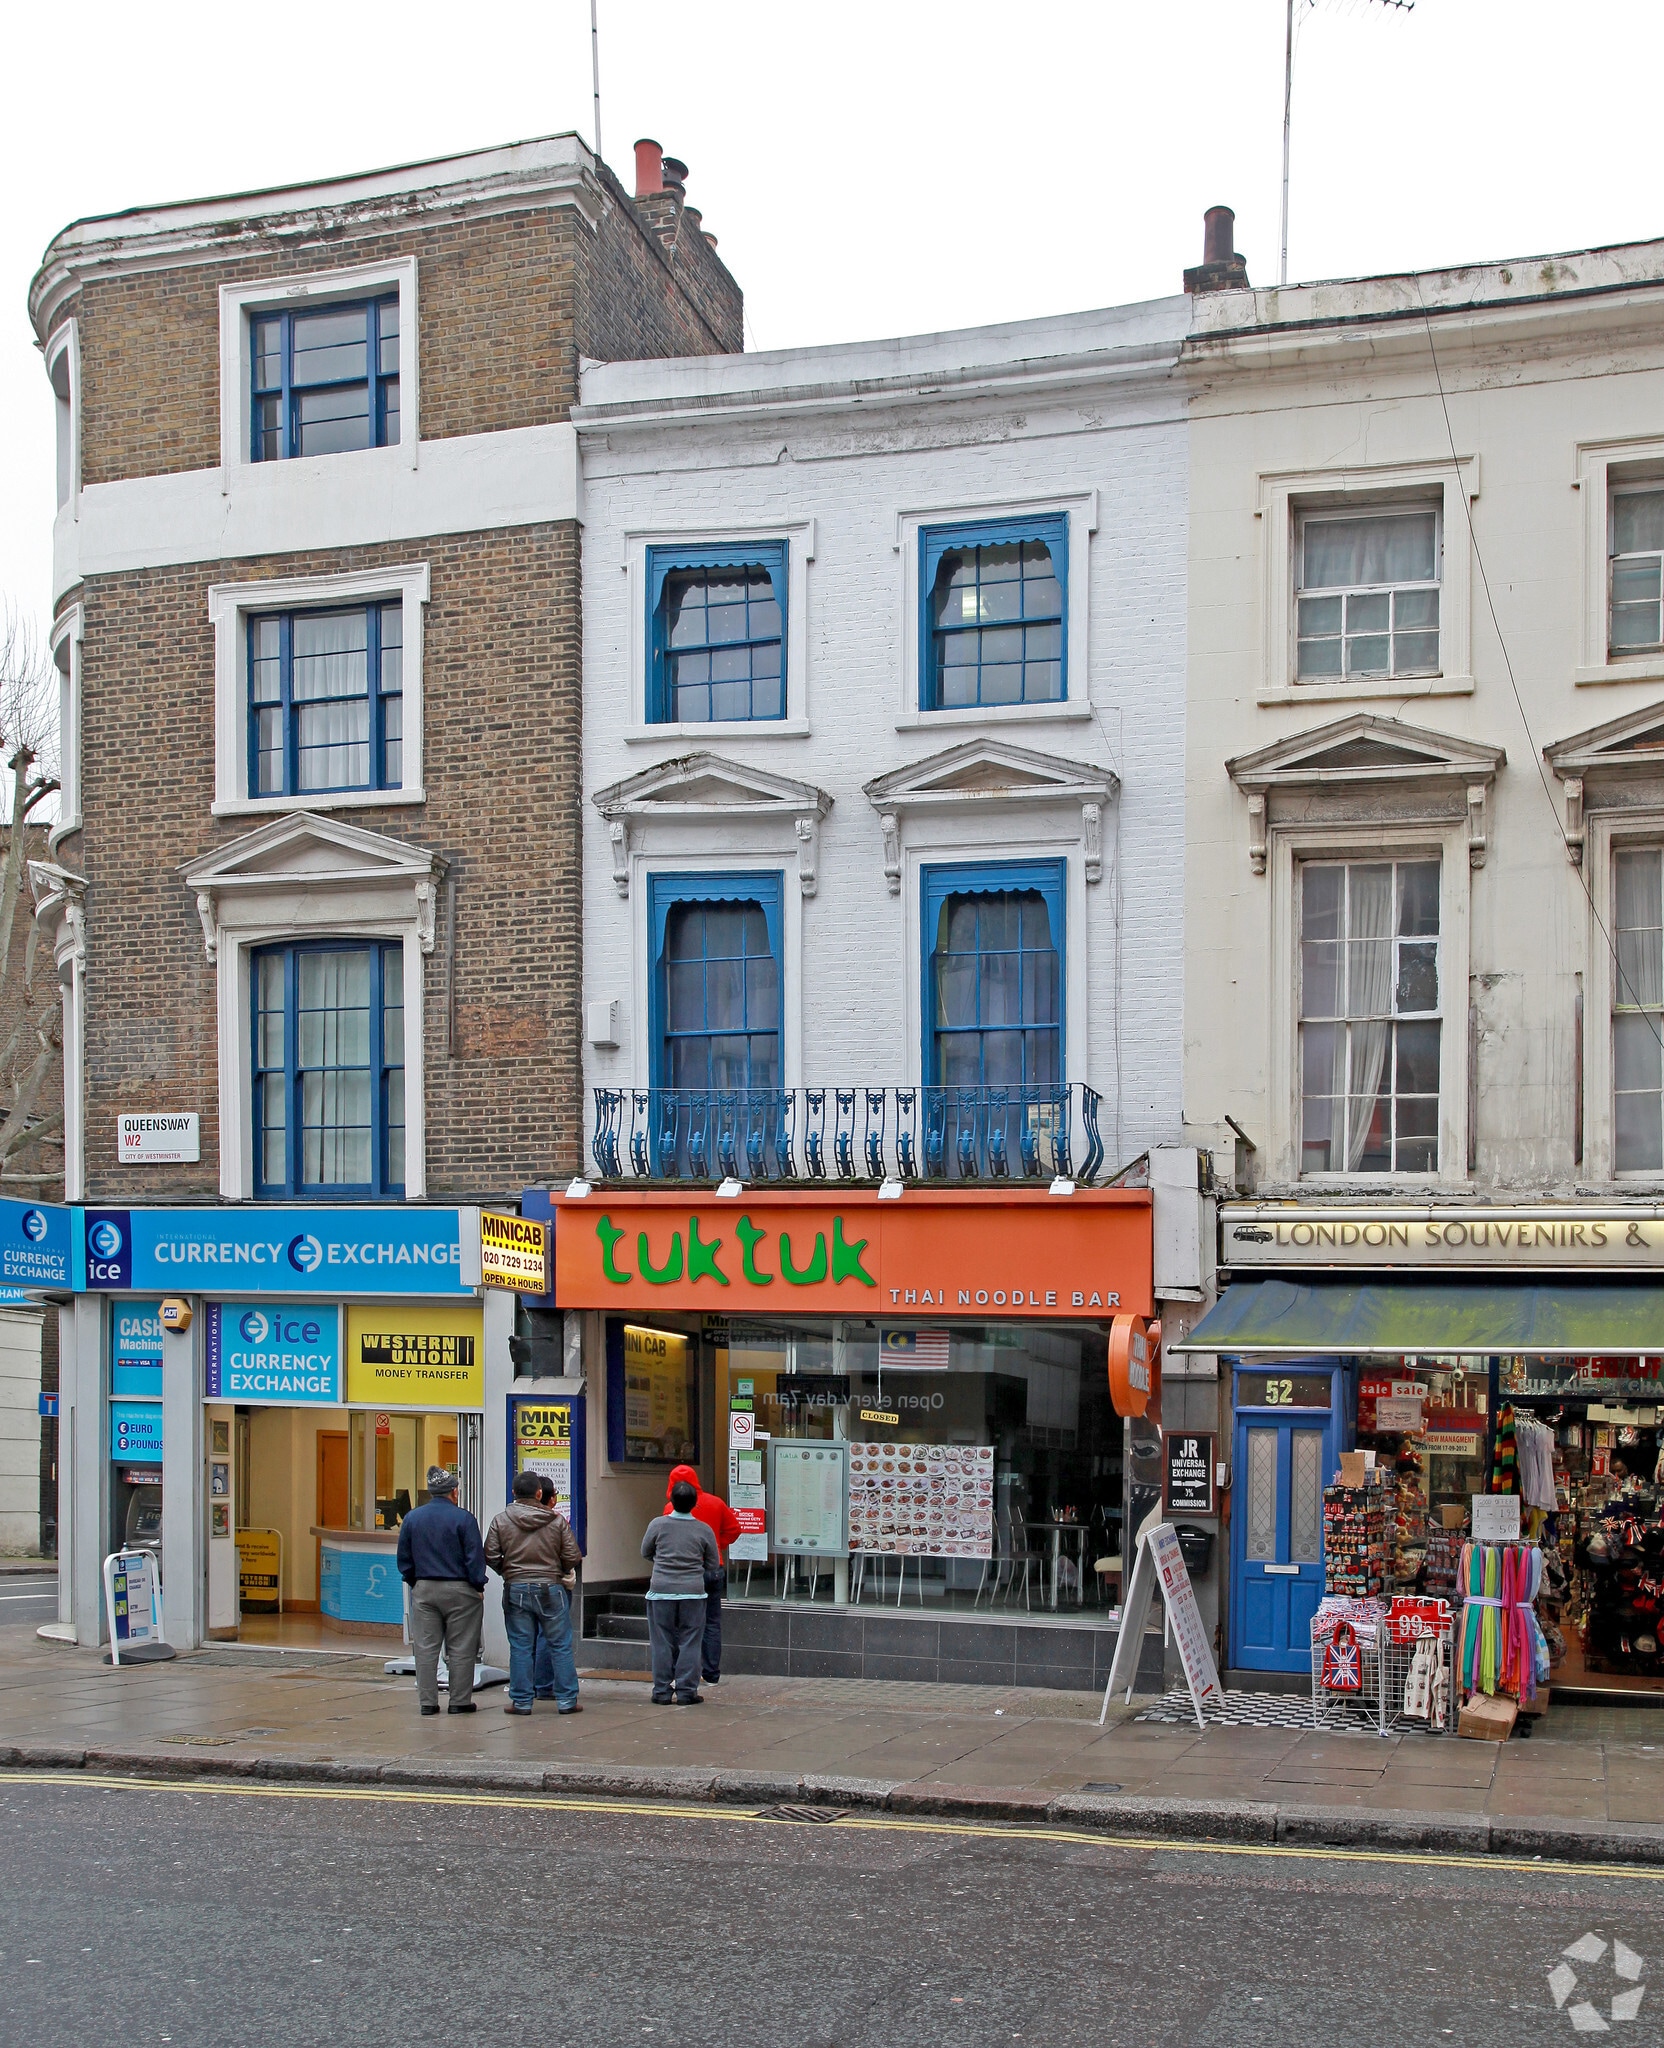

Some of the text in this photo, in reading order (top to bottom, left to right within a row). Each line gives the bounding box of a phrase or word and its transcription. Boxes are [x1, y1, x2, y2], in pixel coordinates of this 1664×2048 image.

[124, 1118, 190, 1131] QUEENSWAY
[124, 1134, 141, 1146] W2
[482, 1216, 542, 1246] MINICAB
[1275, 1222, 1652, 1248] LONDON SOUVENIRS &
[3, 1243, 65, 1255] INTERNATIONAL
[154, 1242, 461, 1264] CURRENCY EXCHANGE
[4, 1250, 65, 1267] CURRENCY
[484, 1251, 543, 1272] 020 7229 1234
[4, 1264, 66, 1281] EXCHANGE
[88, 1259, 121, 1280] ice
[484, 1272, 544, 1290] OPEN 24 HOURS
[890, 1290, 1121, 1307] THAI NOODLE BAR
[164, 1309, 178, 1318] ADT
[274, 1314, 320, 1344] ice
[120, 1338, 163, 1350] Machine
[362, 1334, 455, 1350] WESTERN
[644, 1336, 666, 1358] CAB
[230, 1353, 332, 1372] CURRENCY
[391, 1350, 455, 1364] UNION
[376, 1368, 469, 1380] MONEY TRANSFER
[230, 1374, 331, 1392] EXCHANGE
[1361, 1384, 1423, 1395] sale sale
[1518, 1378, 1582, 1392] BUREAU
[1266, 1380, 1293, 1404] 52
[862, 1412, 898, 1423] CLOSED
[130, 1424, 152, 1434] EURO
[130, 1440, 163, 1450] POUNDS
[1180, 1440, 1198, 1458] JR
[1172, 1459, 1206, 1468] UNIVERSAL
[1172, 1468, 1206, 1478] EXCHANGE
[1172, 1499, 1206, 1507] COMMISSION
